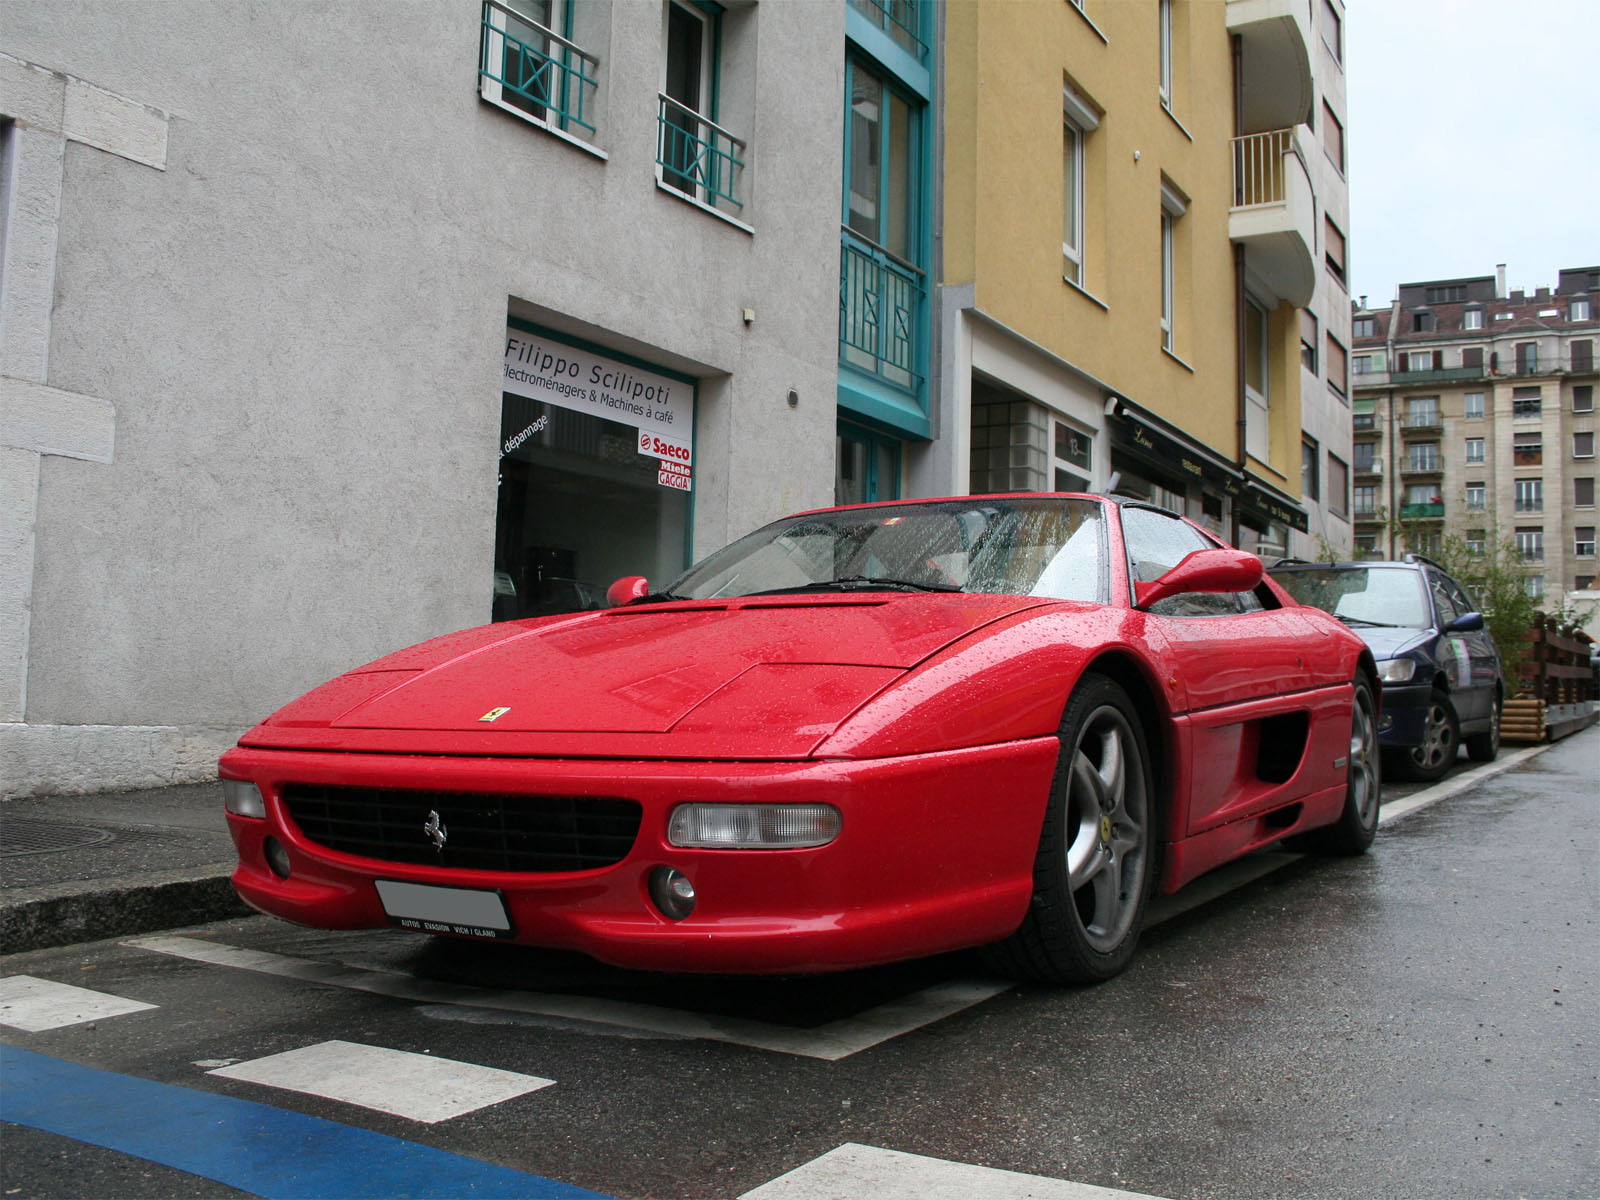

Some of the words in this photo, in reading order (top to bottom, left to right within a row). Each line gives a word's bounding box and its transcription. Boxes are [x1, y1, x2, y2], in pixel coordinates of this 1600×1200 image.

[504, 338, 580, 377] Filippo
[589, 365, 671, 405] Scilipoti
[589, 391, 597, 403] &
[600, 393, 644, 416] Machines
[646, 405, 652, 418] à
[654, 410, 674, 424] café
[504, 415, 548, 453] dépannage
[653, 437, 690, 461] Saeco
[661, 460, 691, 476] Miele
[659, 472, 688, 490] GAGGIA
[401, 919, 421, 928] AUTOS
[424, 922, 451, 933] EVASION
[453, 926, 470, 936] VICH
[474, 929, 497, 938] GLAND
